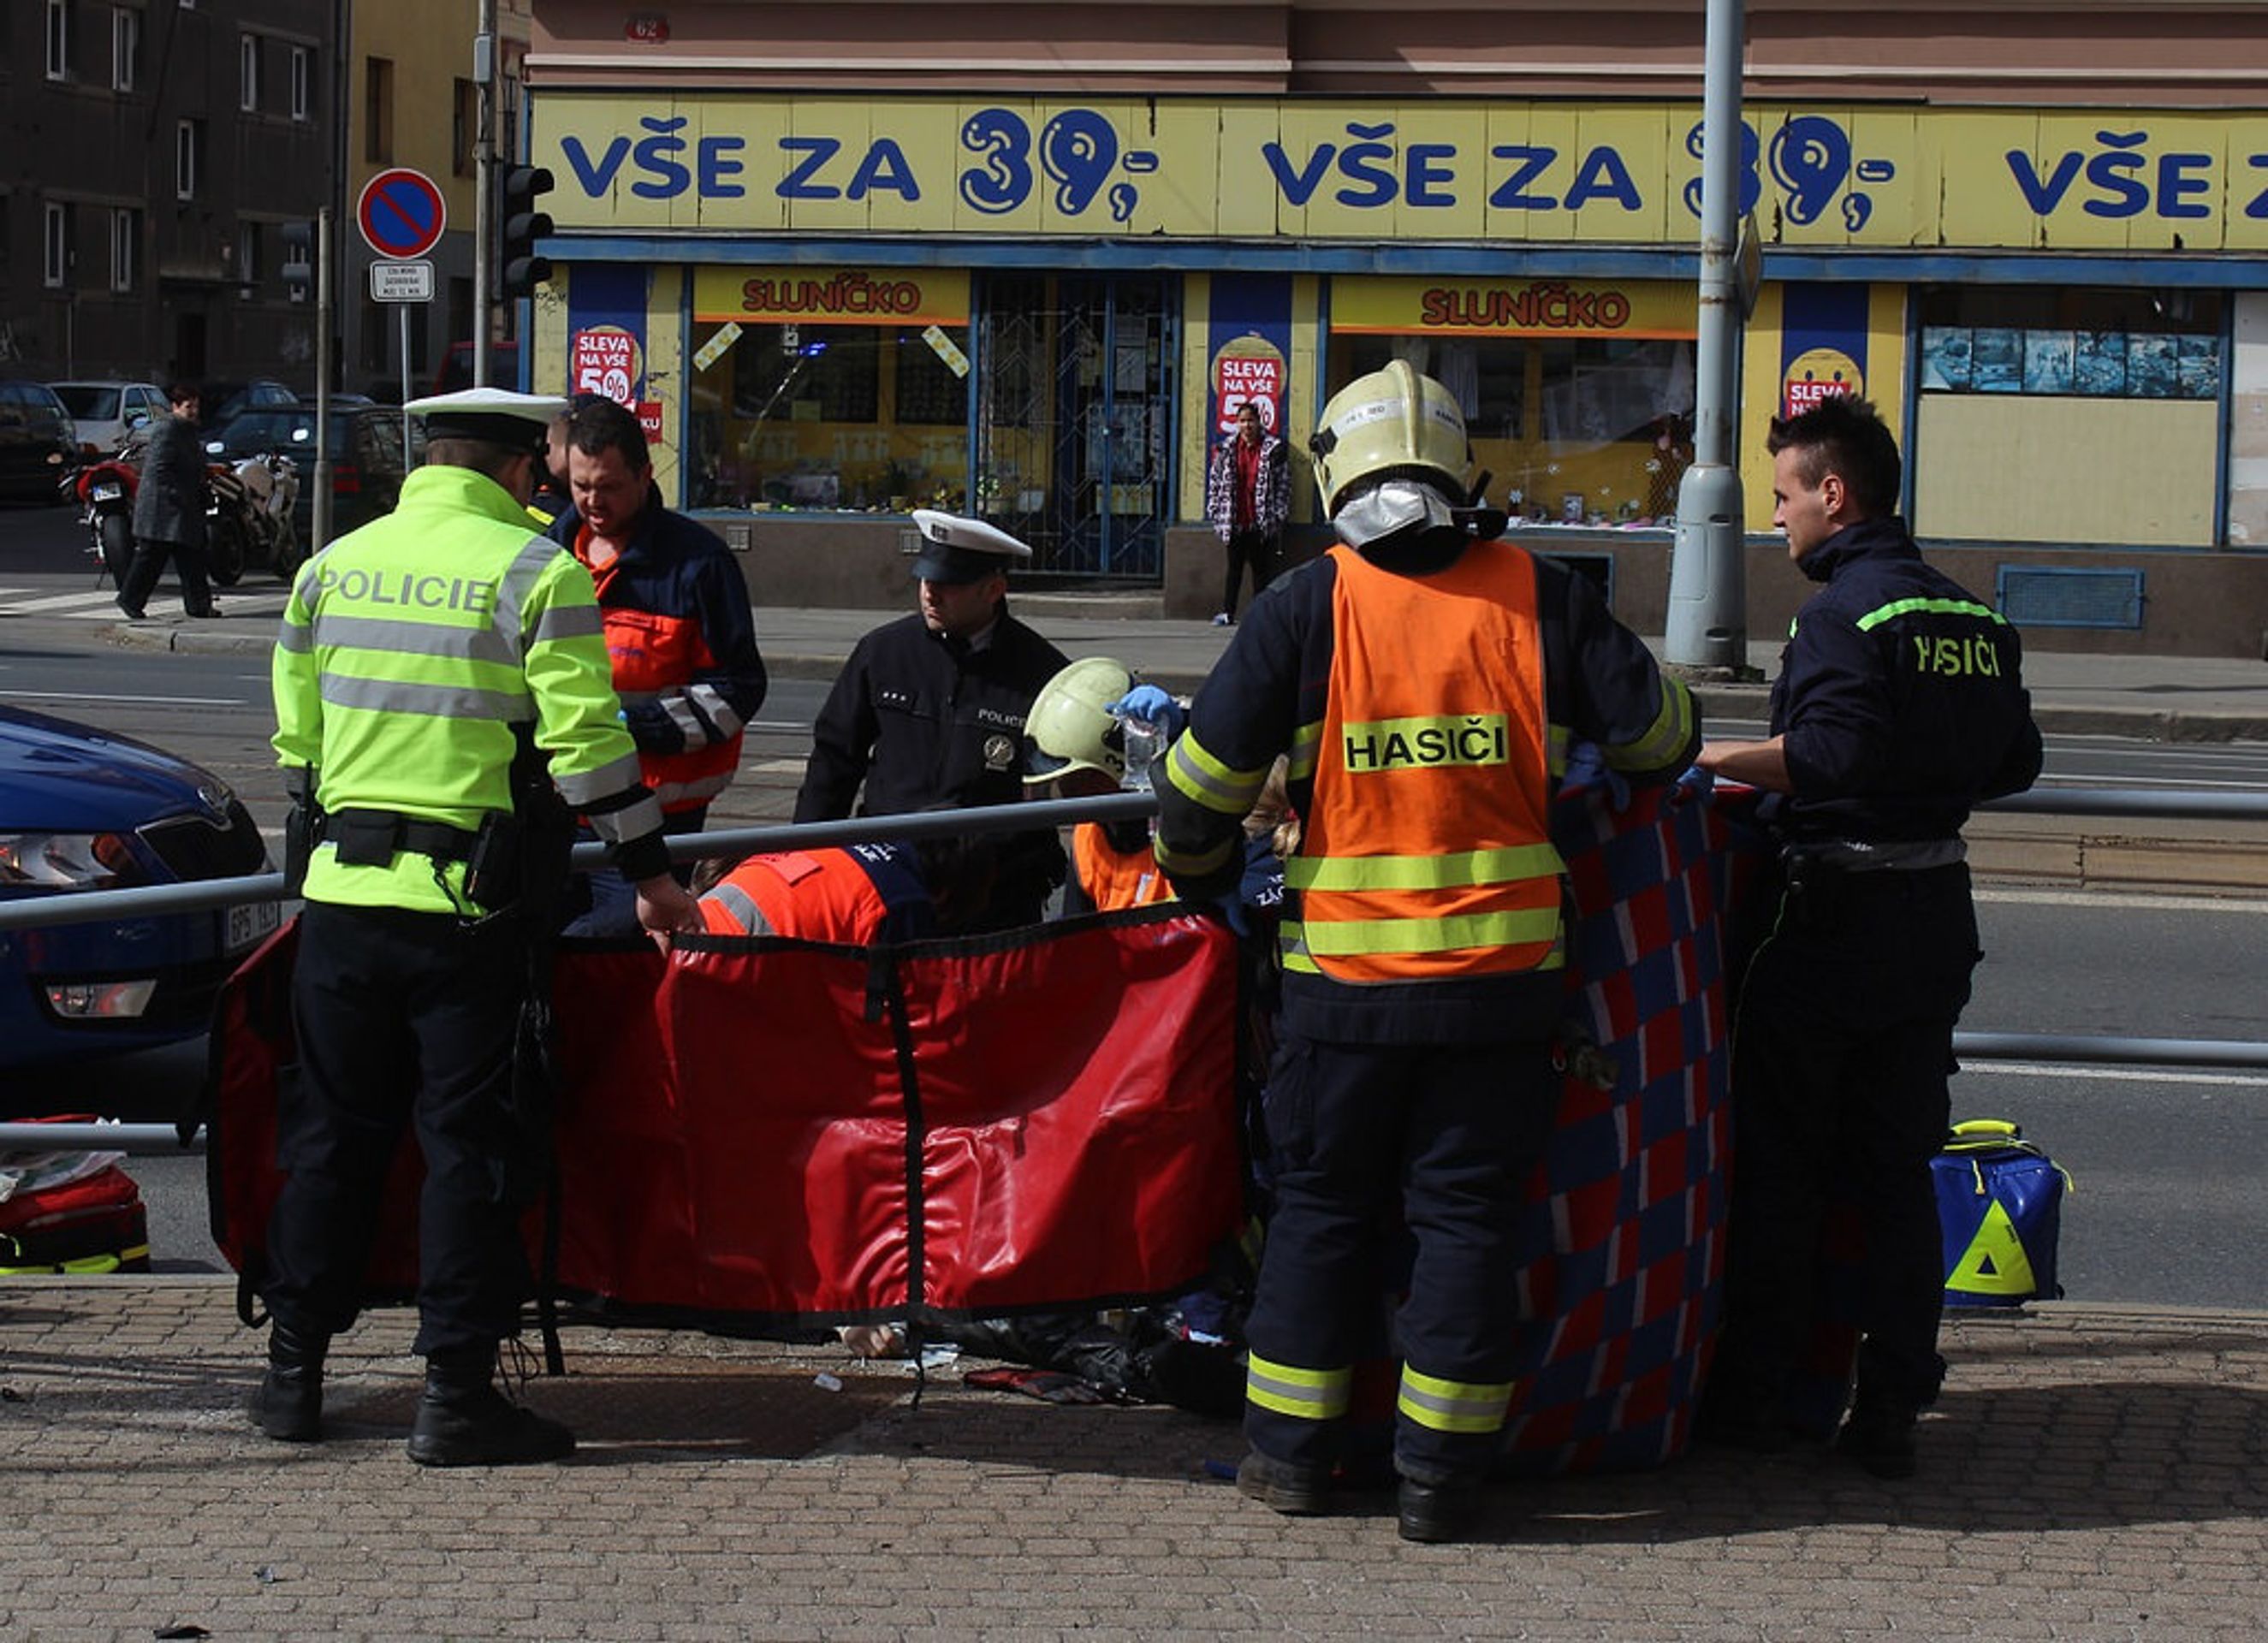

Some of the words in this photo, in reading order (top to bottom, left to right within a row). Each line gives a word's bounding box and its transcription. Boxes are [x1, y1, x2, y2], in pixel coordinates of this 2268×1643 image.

[561, 116, 746, 199] VŠE
[775, 137, 921, 201] ZA
[959, 108, 1160, 222] 39,-
[1262, 122, 1457, 208] VŠE
[1489, 145, 1642, 211] ZA
[2006, 131, 2213, 219] VŠE
[742, 271, 922, 314] SLUNÍČKO
[1421, 282, 1630, 329] SLUNÍČKO
[579, 336, 630, 353] SLEVA
[580, 354, 599, 365] NA
[603, 353, 628, 366] VŠE
[1222, 360, 1275, 377] SLEVA
[1224, 380, 1244, 392] NA
[1247, 378, 1274, 393] VŠE
[319, 568, 496, 613] POLICIE
[1913, 633, 2001, 677] HASIČI
[1346, 717, 1505, 768] HASIČI
